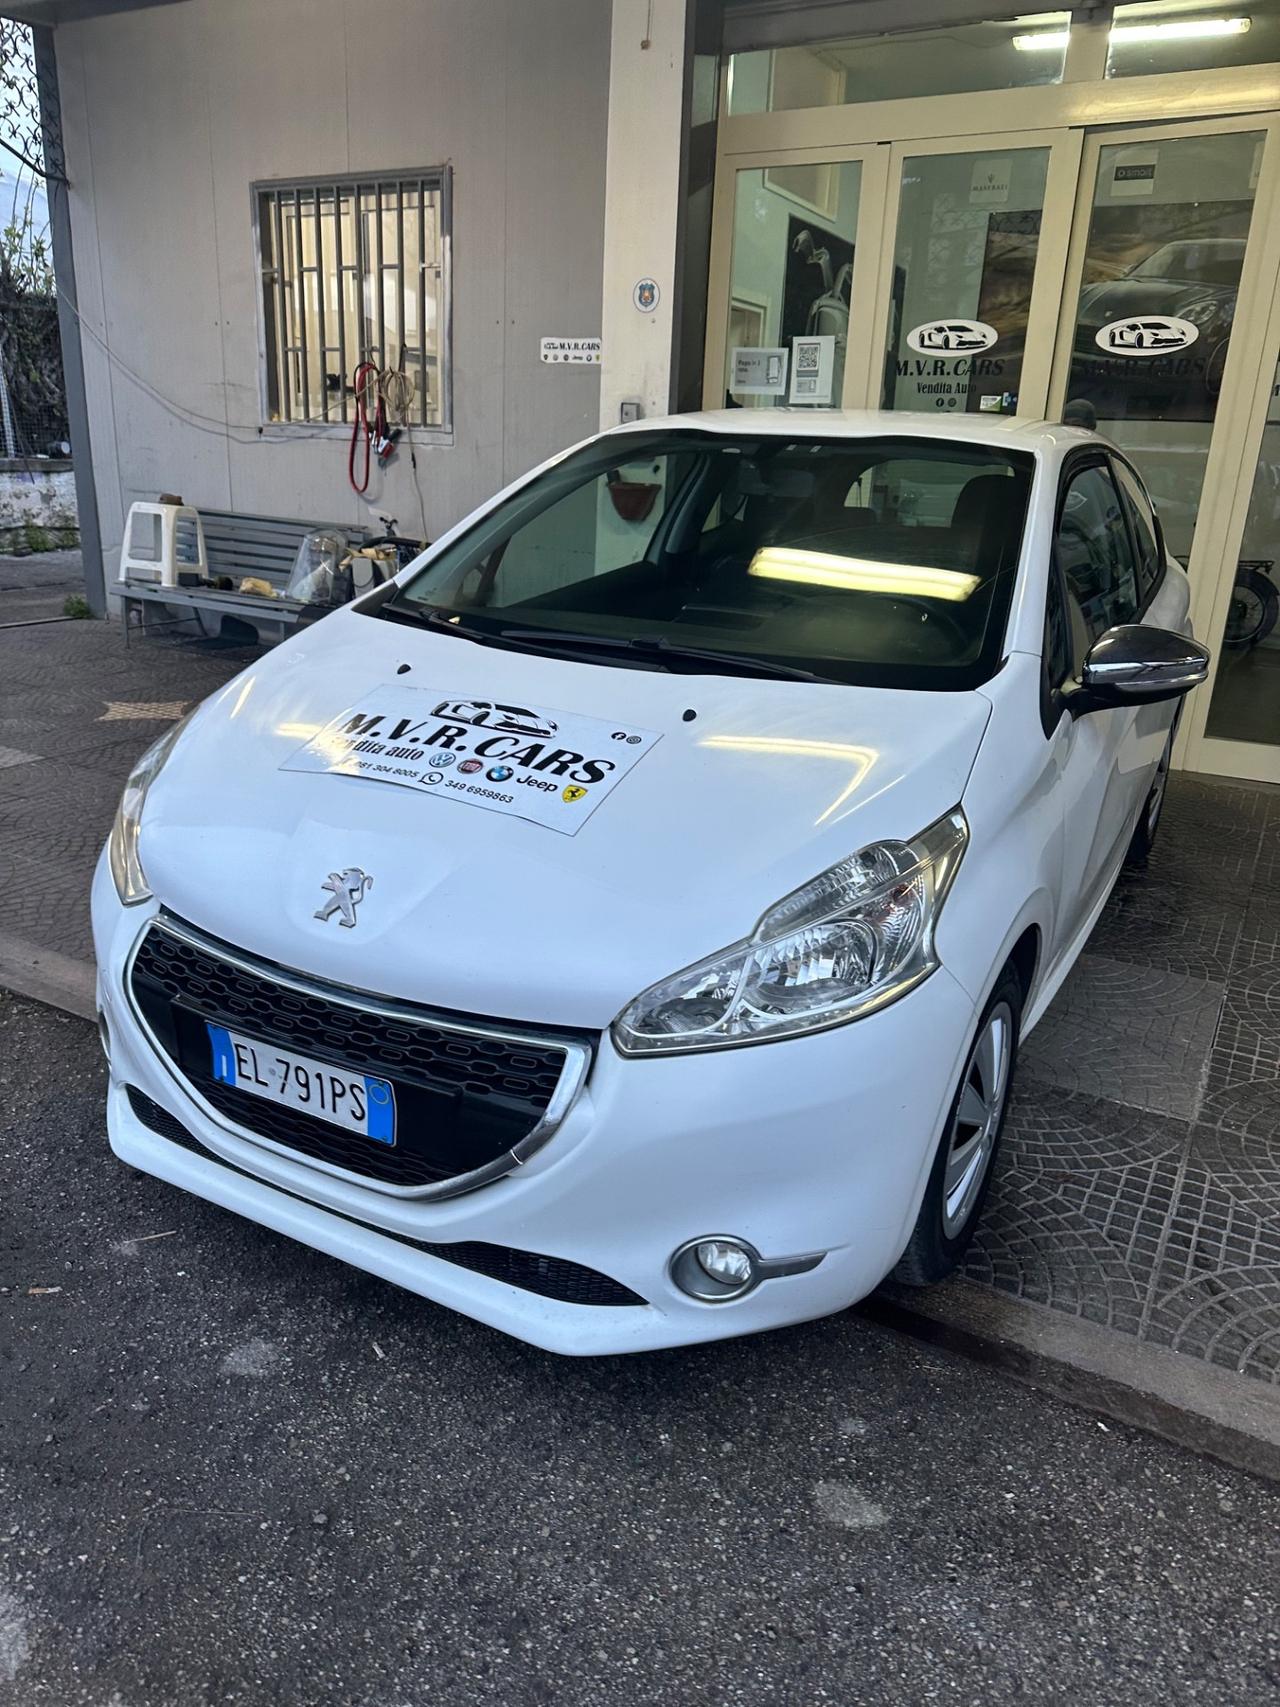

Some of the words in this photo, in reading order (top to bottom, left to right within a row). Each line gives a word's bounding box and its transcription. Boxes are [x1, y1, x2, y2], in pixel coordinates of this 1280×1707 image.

[917, 382, 952, 394] Vendita
[954, 382, 977, 394] Auto
[385, 746, 425, 760] auto
[516, 775, 558, 792] Jeep
[445, 780, 467, 790] 349
[466, 785, 514, 804] 6959863
